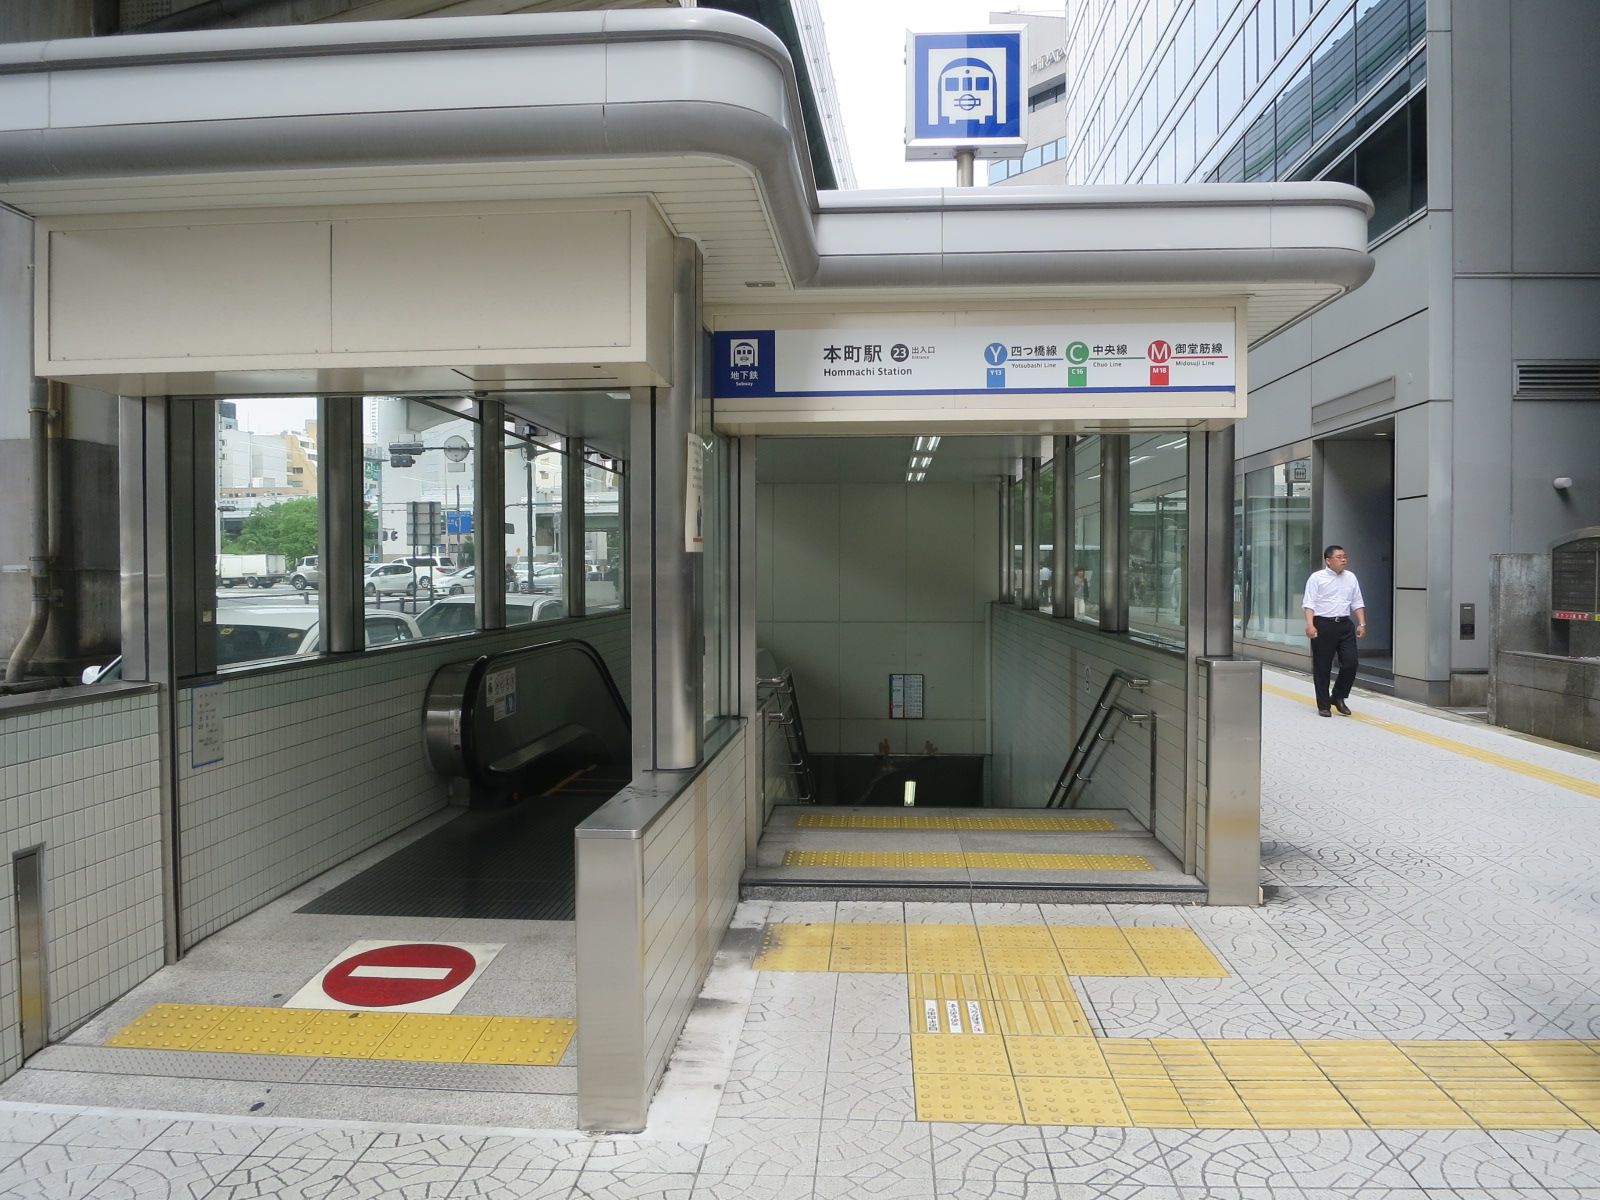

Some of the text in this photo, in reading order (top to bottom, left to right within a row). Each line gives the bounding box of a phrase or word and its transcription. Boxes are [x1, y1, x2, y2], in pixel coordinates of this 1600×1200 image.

[823, 344, 882, 363] 本町駅
[911, 346, 935, 354] 出入口
[989, 346, 1002, 363] Y
[1011, 345, 1057, 357] 四つ橋線
[1069, 344, 1084, 362] C
[1093, 344, 1128, 356] 中央線
[1151, 343, 1168, 360] M
[1175, 343, 1223, 355] 御堂筋線
[730, 370, 759, 380] 地下鉄
[824, 367, 912, 377] Hommachi Station
